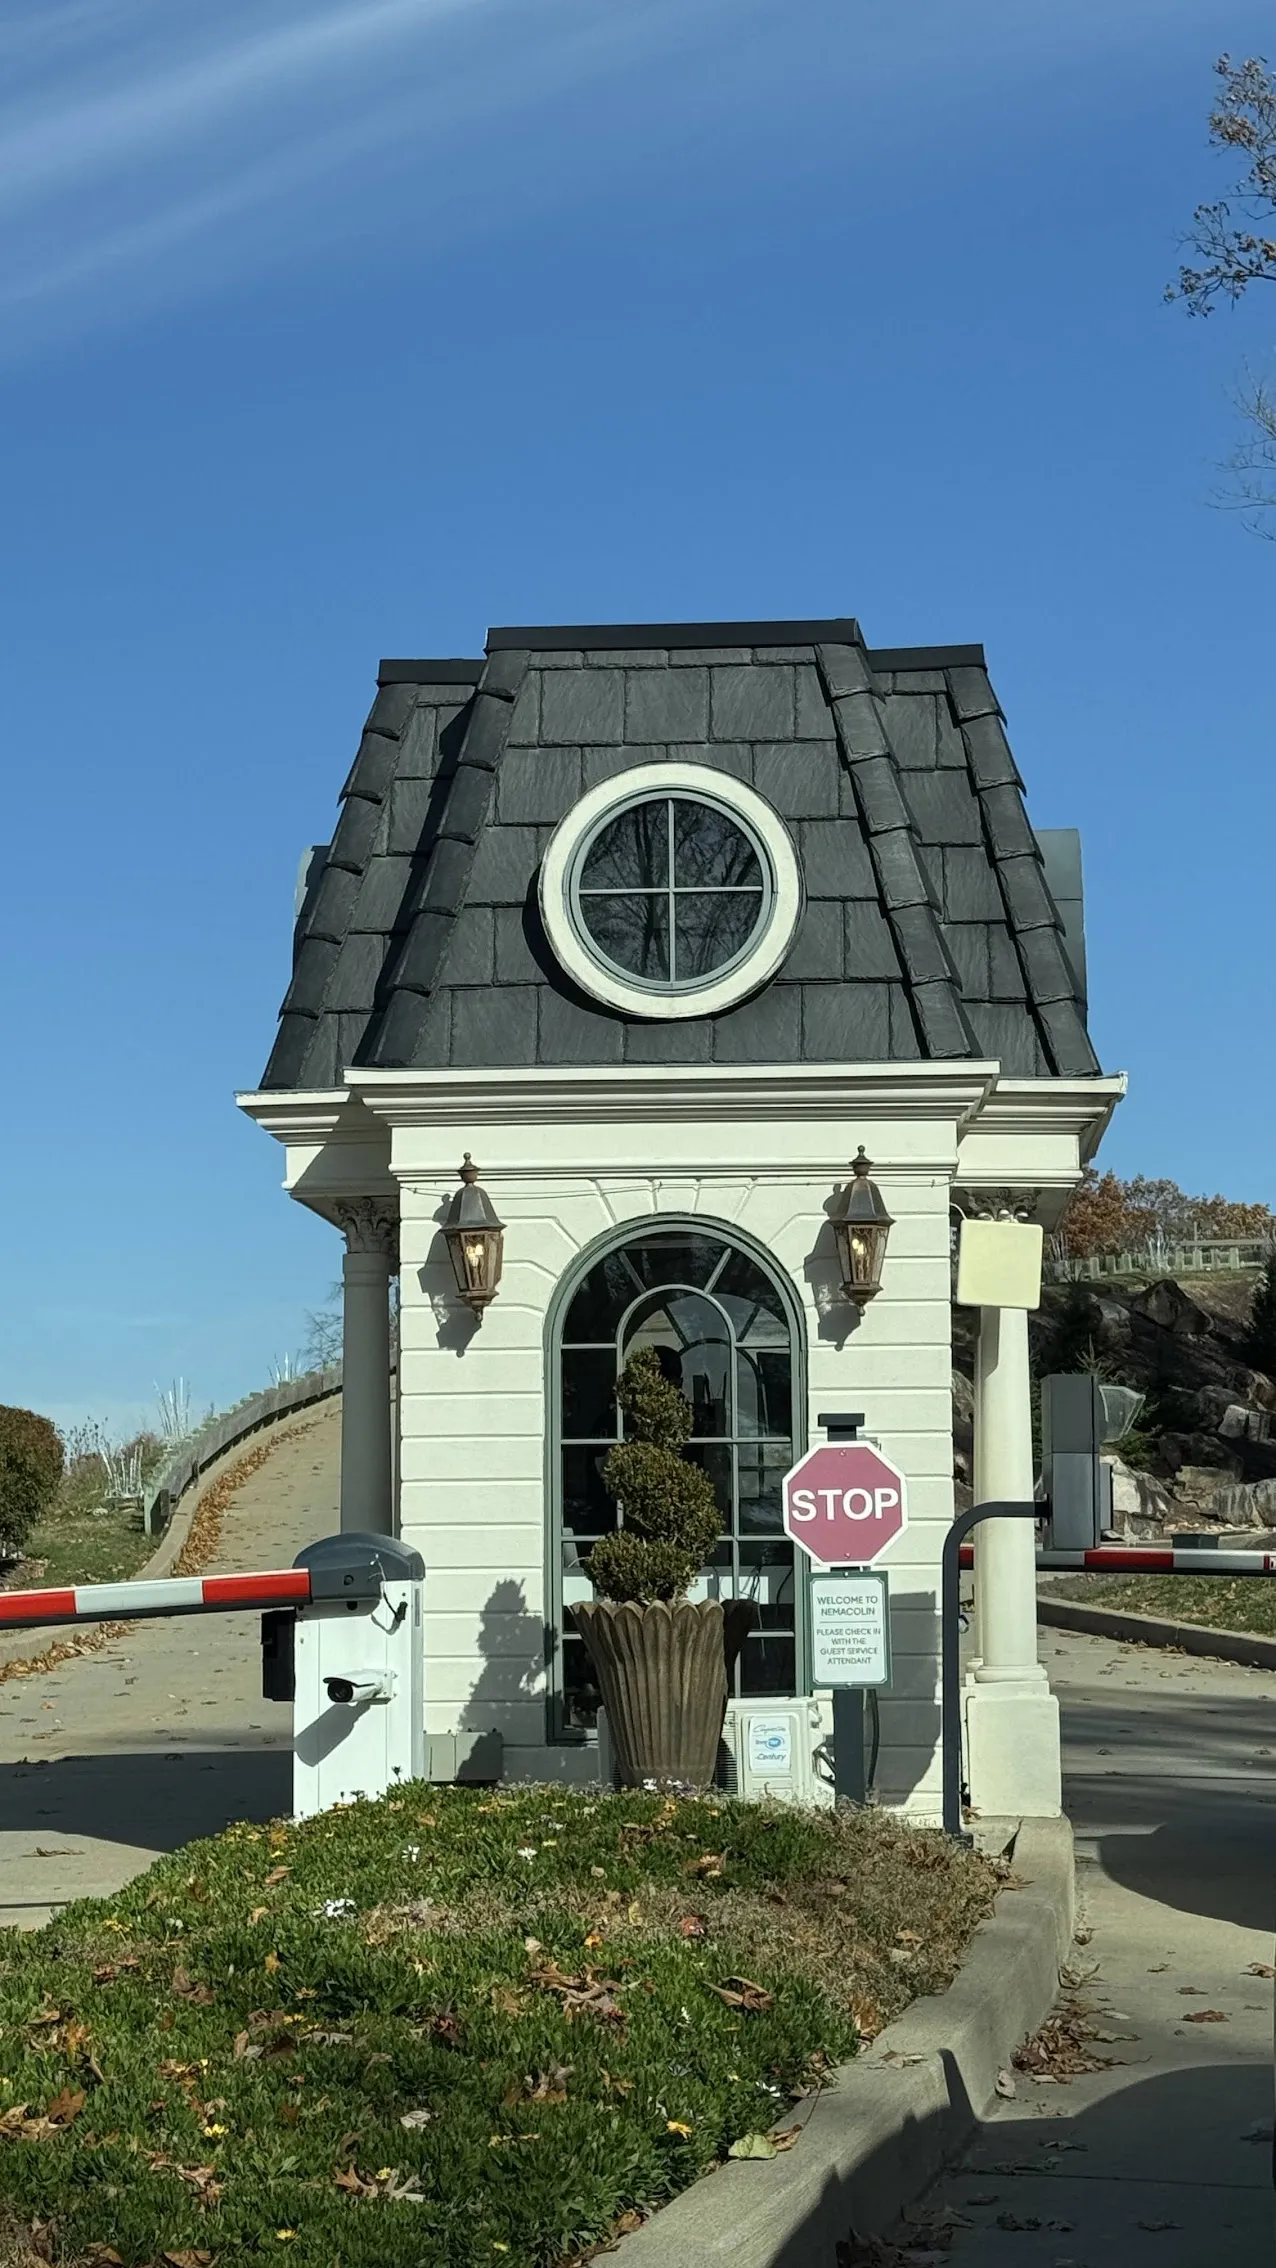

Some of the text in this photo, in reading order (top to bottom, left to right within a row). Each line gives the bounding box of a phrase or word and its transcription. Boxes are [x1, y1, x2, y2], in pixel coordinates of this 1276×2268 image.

[791, 1487, 899, 1522] STOP
[817, 1595, 878, 1605] WELCOME TO
[821, 1607, 875, 1616] NEMACOLIN
[816, 1627, 881, 1636] PLEASE CHECK IN
[820, 1647, 878, 1655] GUEST SERVICE
[827, 1657, 872, 1665] ATTENDANT
